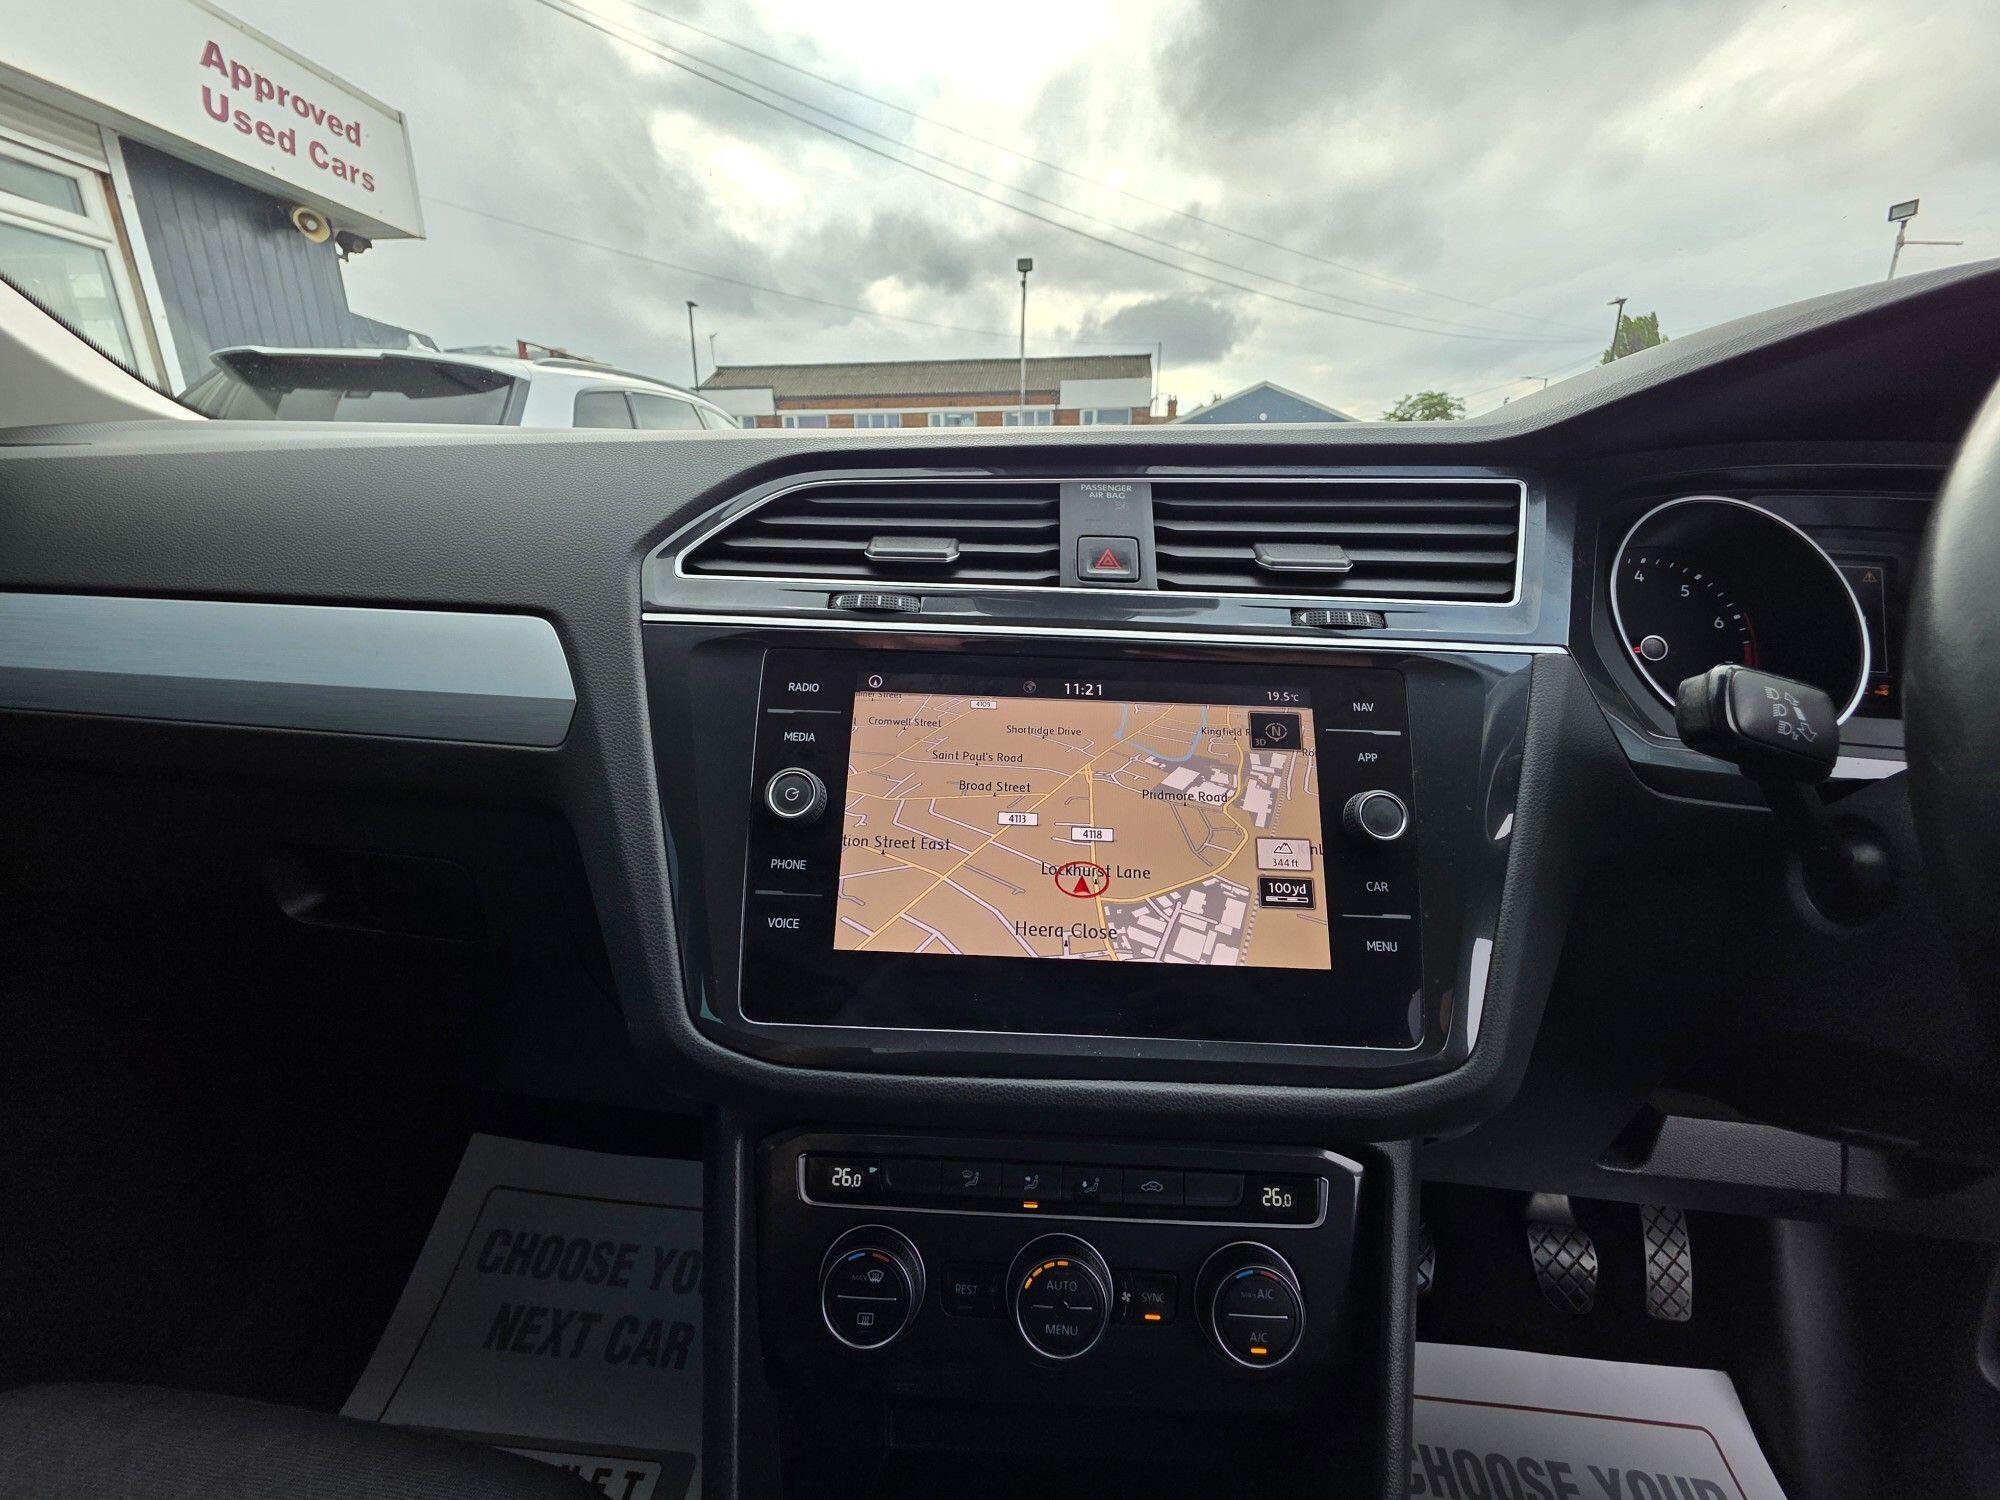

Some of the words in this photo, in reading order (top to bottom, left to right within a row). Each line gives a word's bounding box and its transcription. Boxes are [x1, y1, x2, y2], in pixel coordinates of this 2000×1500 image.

[200, 39, 362, 148] Approved
[202, 84, 296, 157] Used
[308, 140, 375, 193] Cars
[1080, 484, 1132, 492] PASSENGER
[1634, 570, 1645, 583] 4
[1680, 585, 1690, 598] 5
[1714, 616, 1724, 629] 6
[788, 682, 820, 693] RADIO
[1064, 683, 1103, 696] 11:21
[1352, 702, 1374, 713] NAV
[868, 716, 911, 727] Cromwell
[914, 719, 942, 728] Street
[783, 731, 816, 742] MEDIA
[1006, 725, 1055, 736] Shortridge
[1057, 727, 1082, 736] Drive
[1201, 727, 1242, 737] Kingfield
[932, 750, 959, 761] Saint
[963, 752, 994, 763] Paul's
[997, 752, 1023, 763] Road
[1357, 753, 1378, 762] APP
[959, 780, 992, 792] Broad
[997, 782, 1031, 793] Street
[1142, 789, 1194, 801] Pridmore
[1198, 792, 1228, 803] Road
[1008, 813, 1027, 824] 4113
[1082, 829, 1103, 840] 4118
[874, 836, 916, 849] Street
[921, 837, 950, 851] East
[770, 858, 807, 870] PHONE
[1041, 862, 1111, 877] Lockhurst
[1116, 865, 1151, 879] Lane
[1366, 882, 1389, 893] CAR
[767, 917, 800, 929] VOICE
[1015, 922, 1064, 938] Heera
[1070, 923, 1117, 941] Close
[1366, 941, 1398, 953] MENU
[476, 1228, 641, 1288] CHOOSE
[650, 1246, 704, 1296] YO
[955, 1283, 978, 1295] REST
[1046, 1280, 1078, 1292] AUTO
[1141, 1292, 1165, 1303] SYNC
[1256, 1288, 1275, 1300] A/C
[1045, 1324, 1078, 1336] MENU
[482, 1303, 603, 1359] NEXT
[604, 1314, 695, 1370] CAR
[1250, 1332, 1268, 1343] A/C
